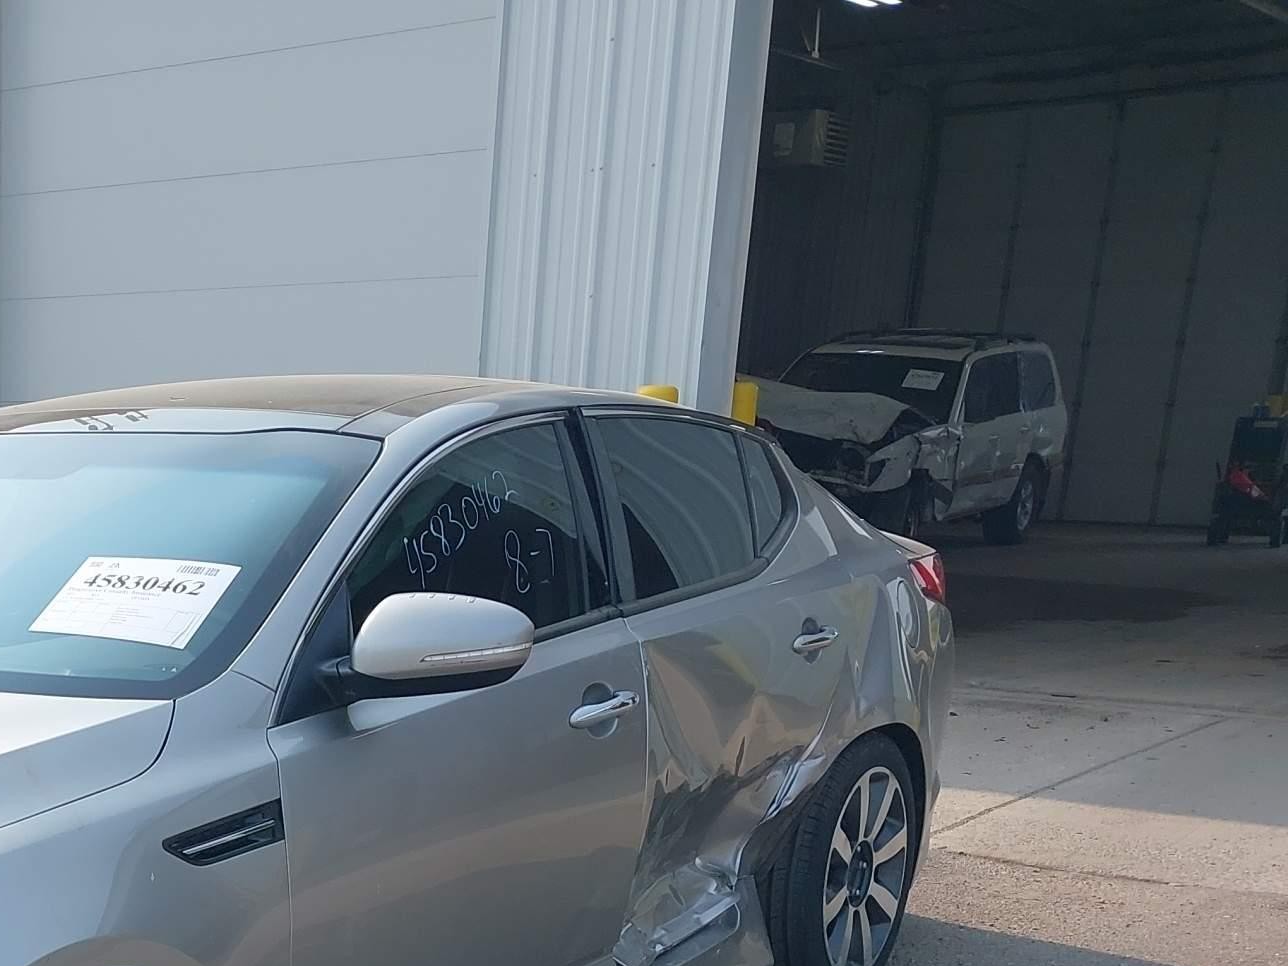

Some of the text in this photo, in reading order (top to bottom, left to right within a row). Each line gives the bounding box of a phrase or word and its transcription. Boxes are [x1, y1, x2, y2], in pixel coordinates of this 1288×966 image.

[402, 471, 520, 590] 45830462
[504, 528, 556, 593] 8-7
[83, 573, 207, 596] 45830462
